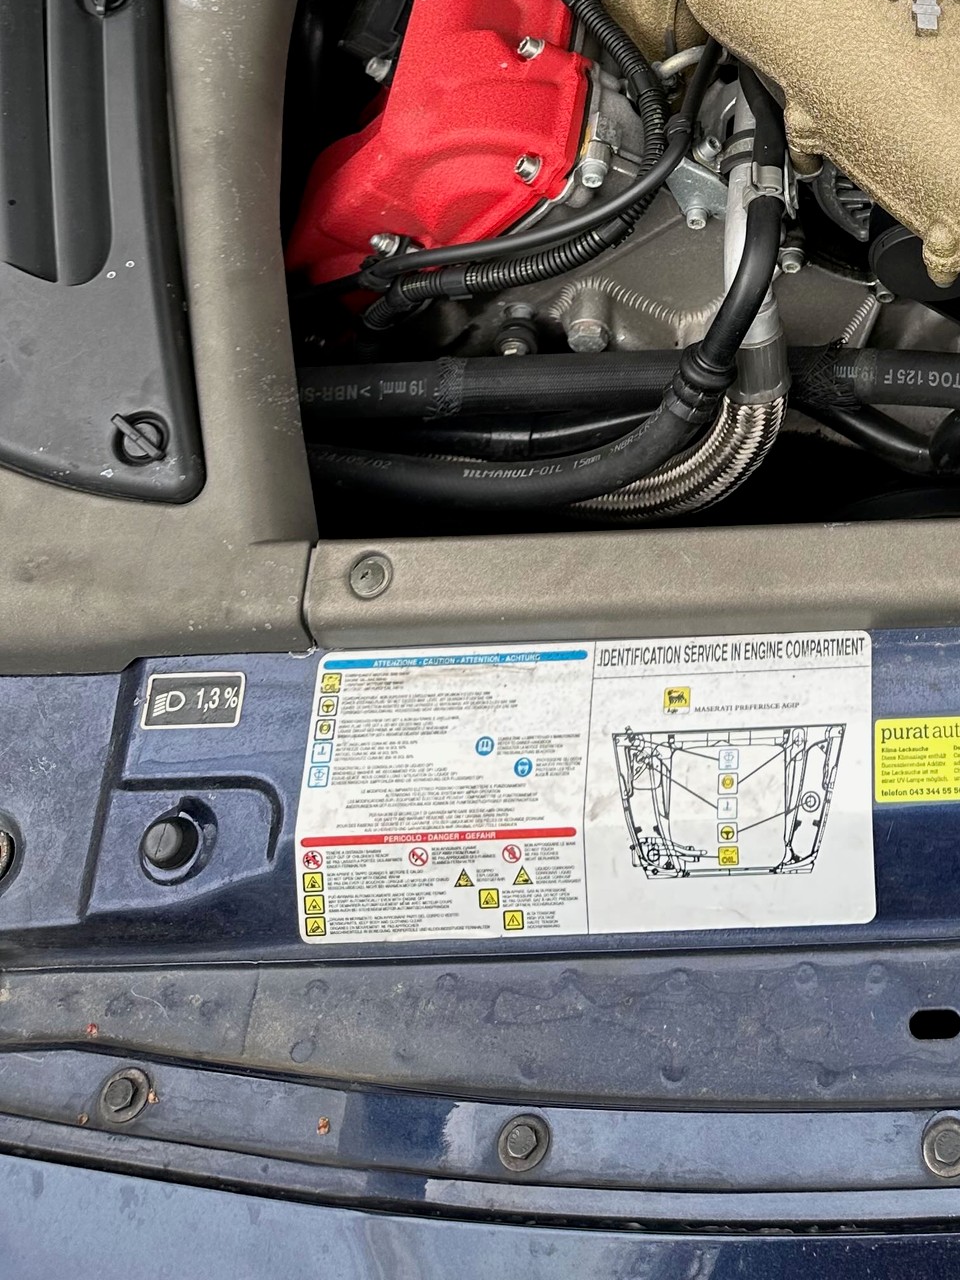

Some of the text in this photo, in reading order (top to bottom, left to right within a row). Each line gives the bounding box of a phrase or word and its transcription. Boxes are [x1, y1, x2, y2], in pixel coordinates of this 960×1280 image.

[884, 368, 893, 384] F
[600, 637, 865, 667] IDENTIFICATION SERVICE IN ENGINE COMPARTMENT
[373, 653, 541, 668] ATTENZIONE CAUTION ATTENTION ACHTUNG
[694, 701, 800, 713] MASERATI PREFERISCE AGIP
[881, 723, 930, 744] purat
[881, 788, 908, 797] telefon
[926, 787, 941, 795] 344
[383, 831, 496, 843] PERICOLO DANGER GEFAHR
[721, 855, 737, 864] OIL
